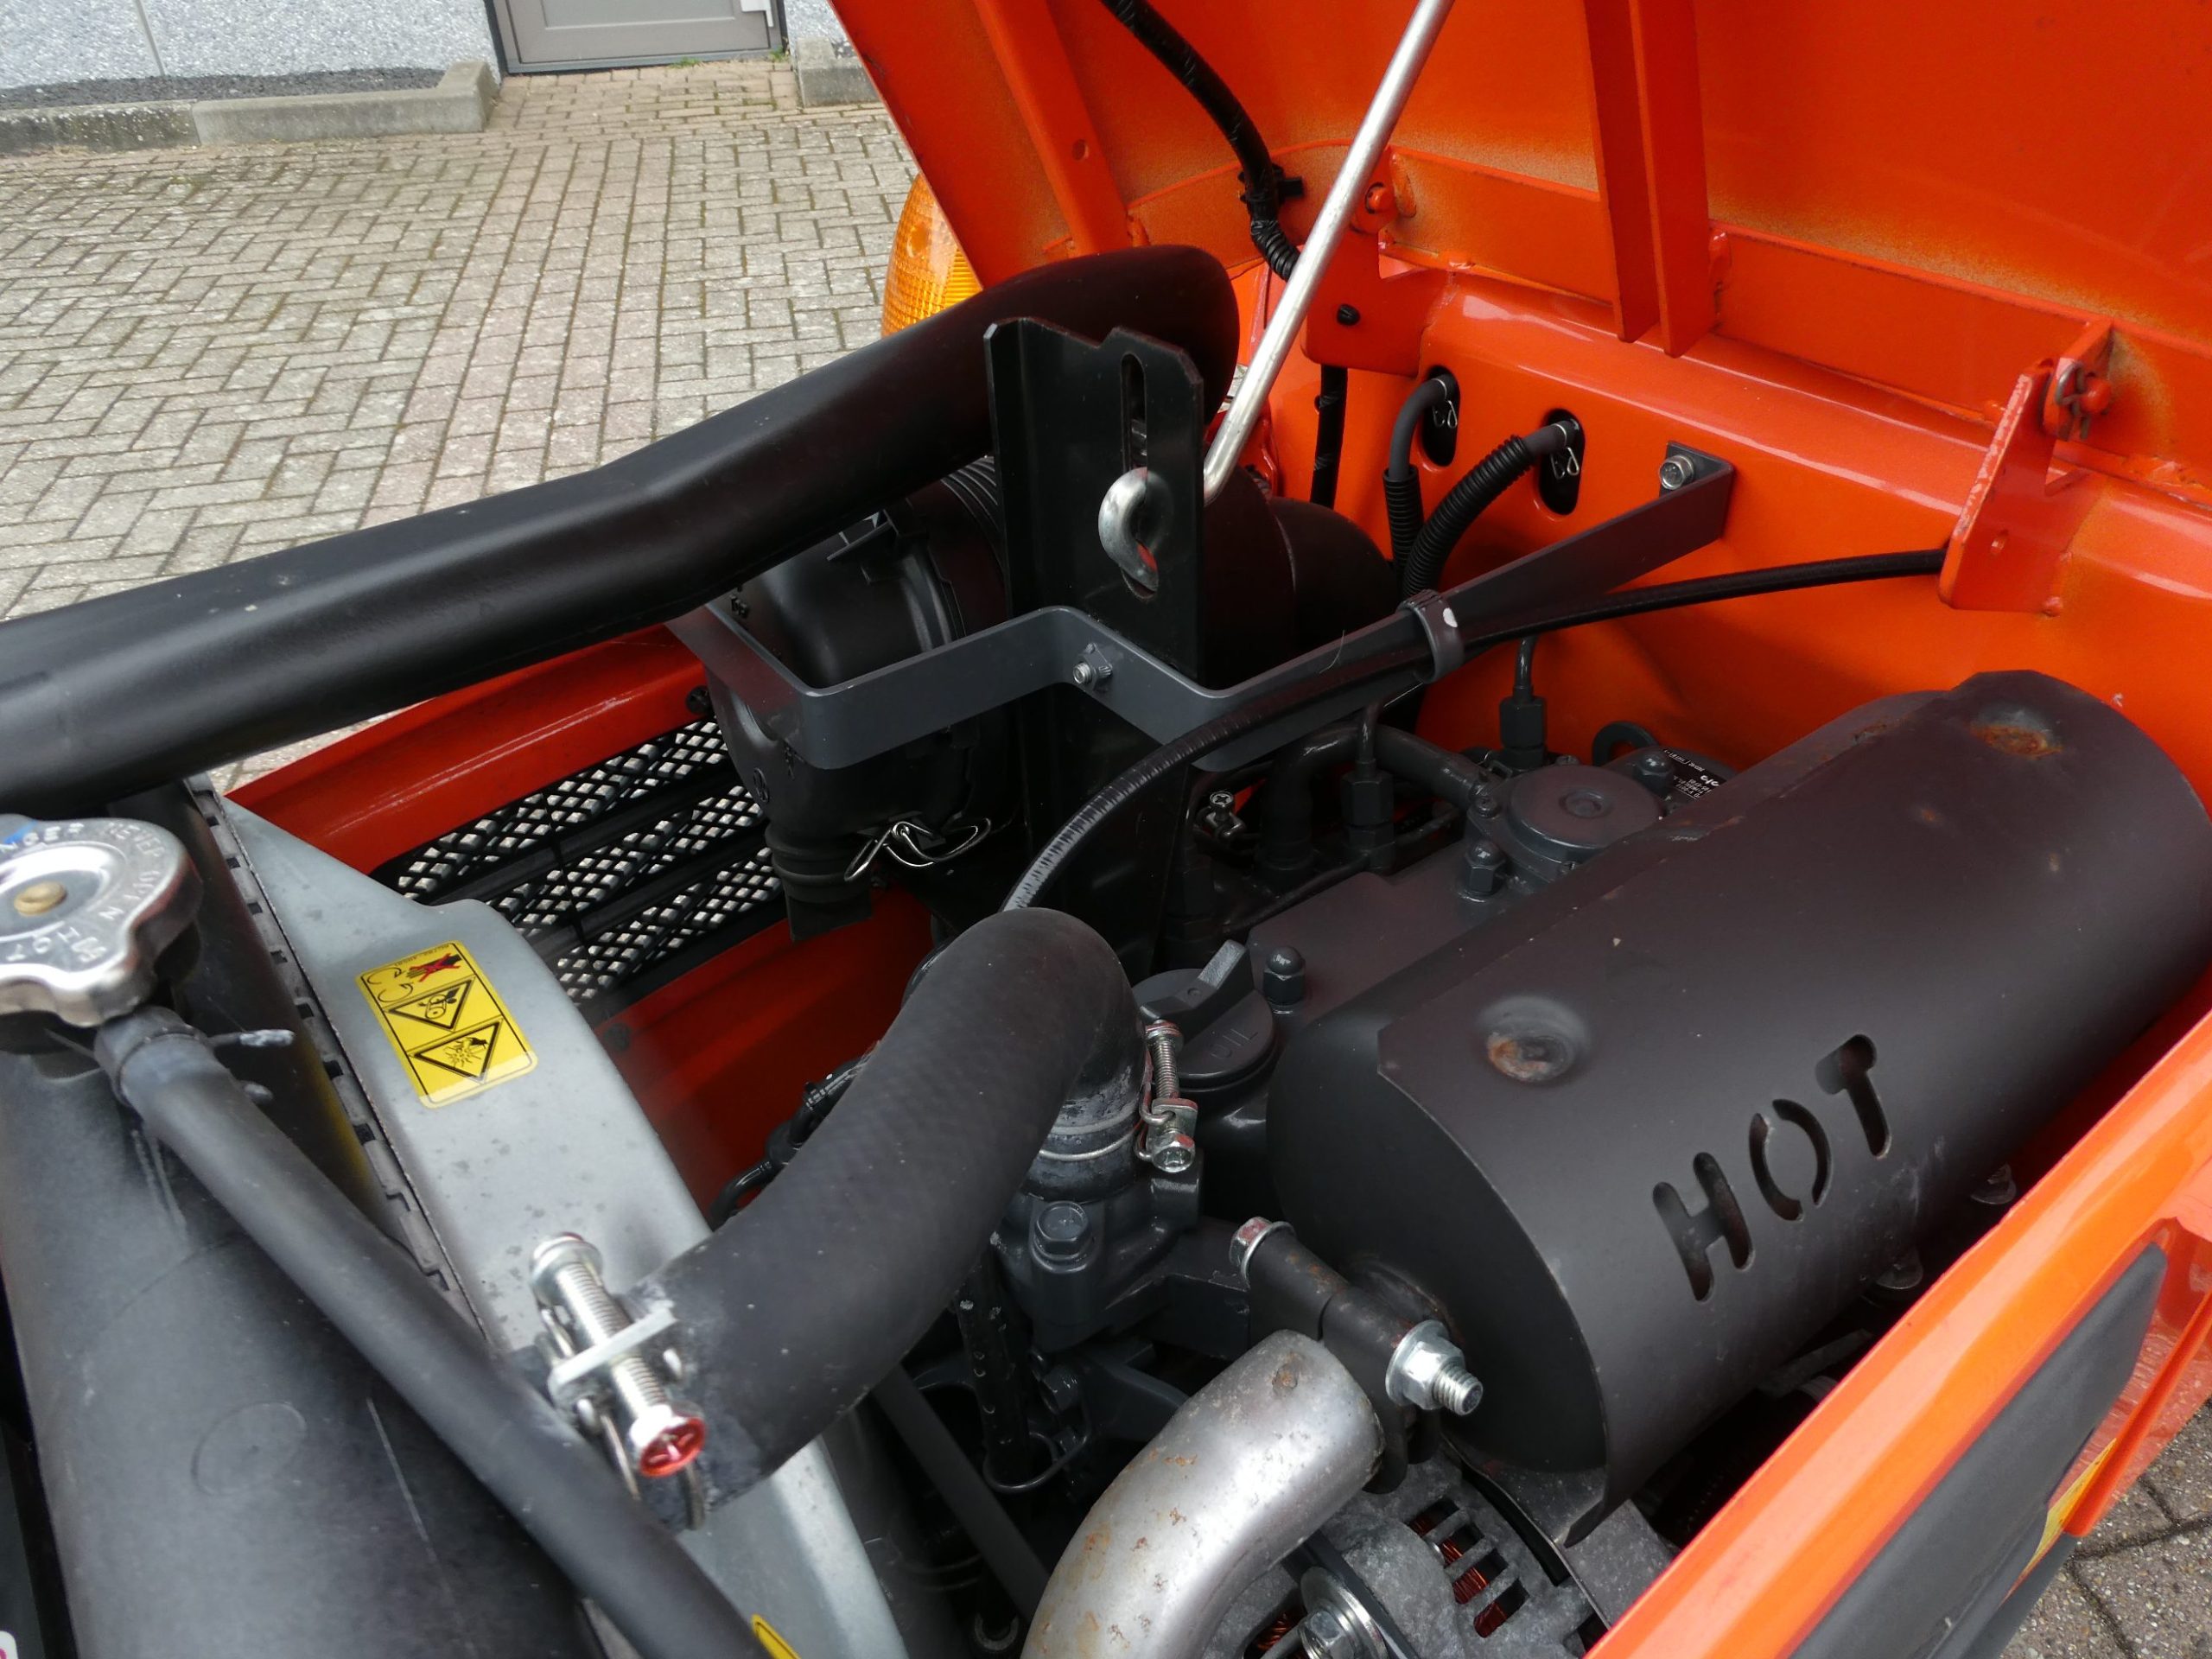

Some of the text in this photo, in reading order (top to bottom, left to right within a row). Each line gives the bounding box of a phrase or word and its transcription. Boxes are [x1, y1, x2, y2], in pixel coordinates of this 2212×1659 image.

[107, 821, 166, 858] NEVER
[6, 926, 81, 962] HOT
[1210, 1028, 1258, 1060] OIL
[1652, 1033, 1892, 1303] HOT
